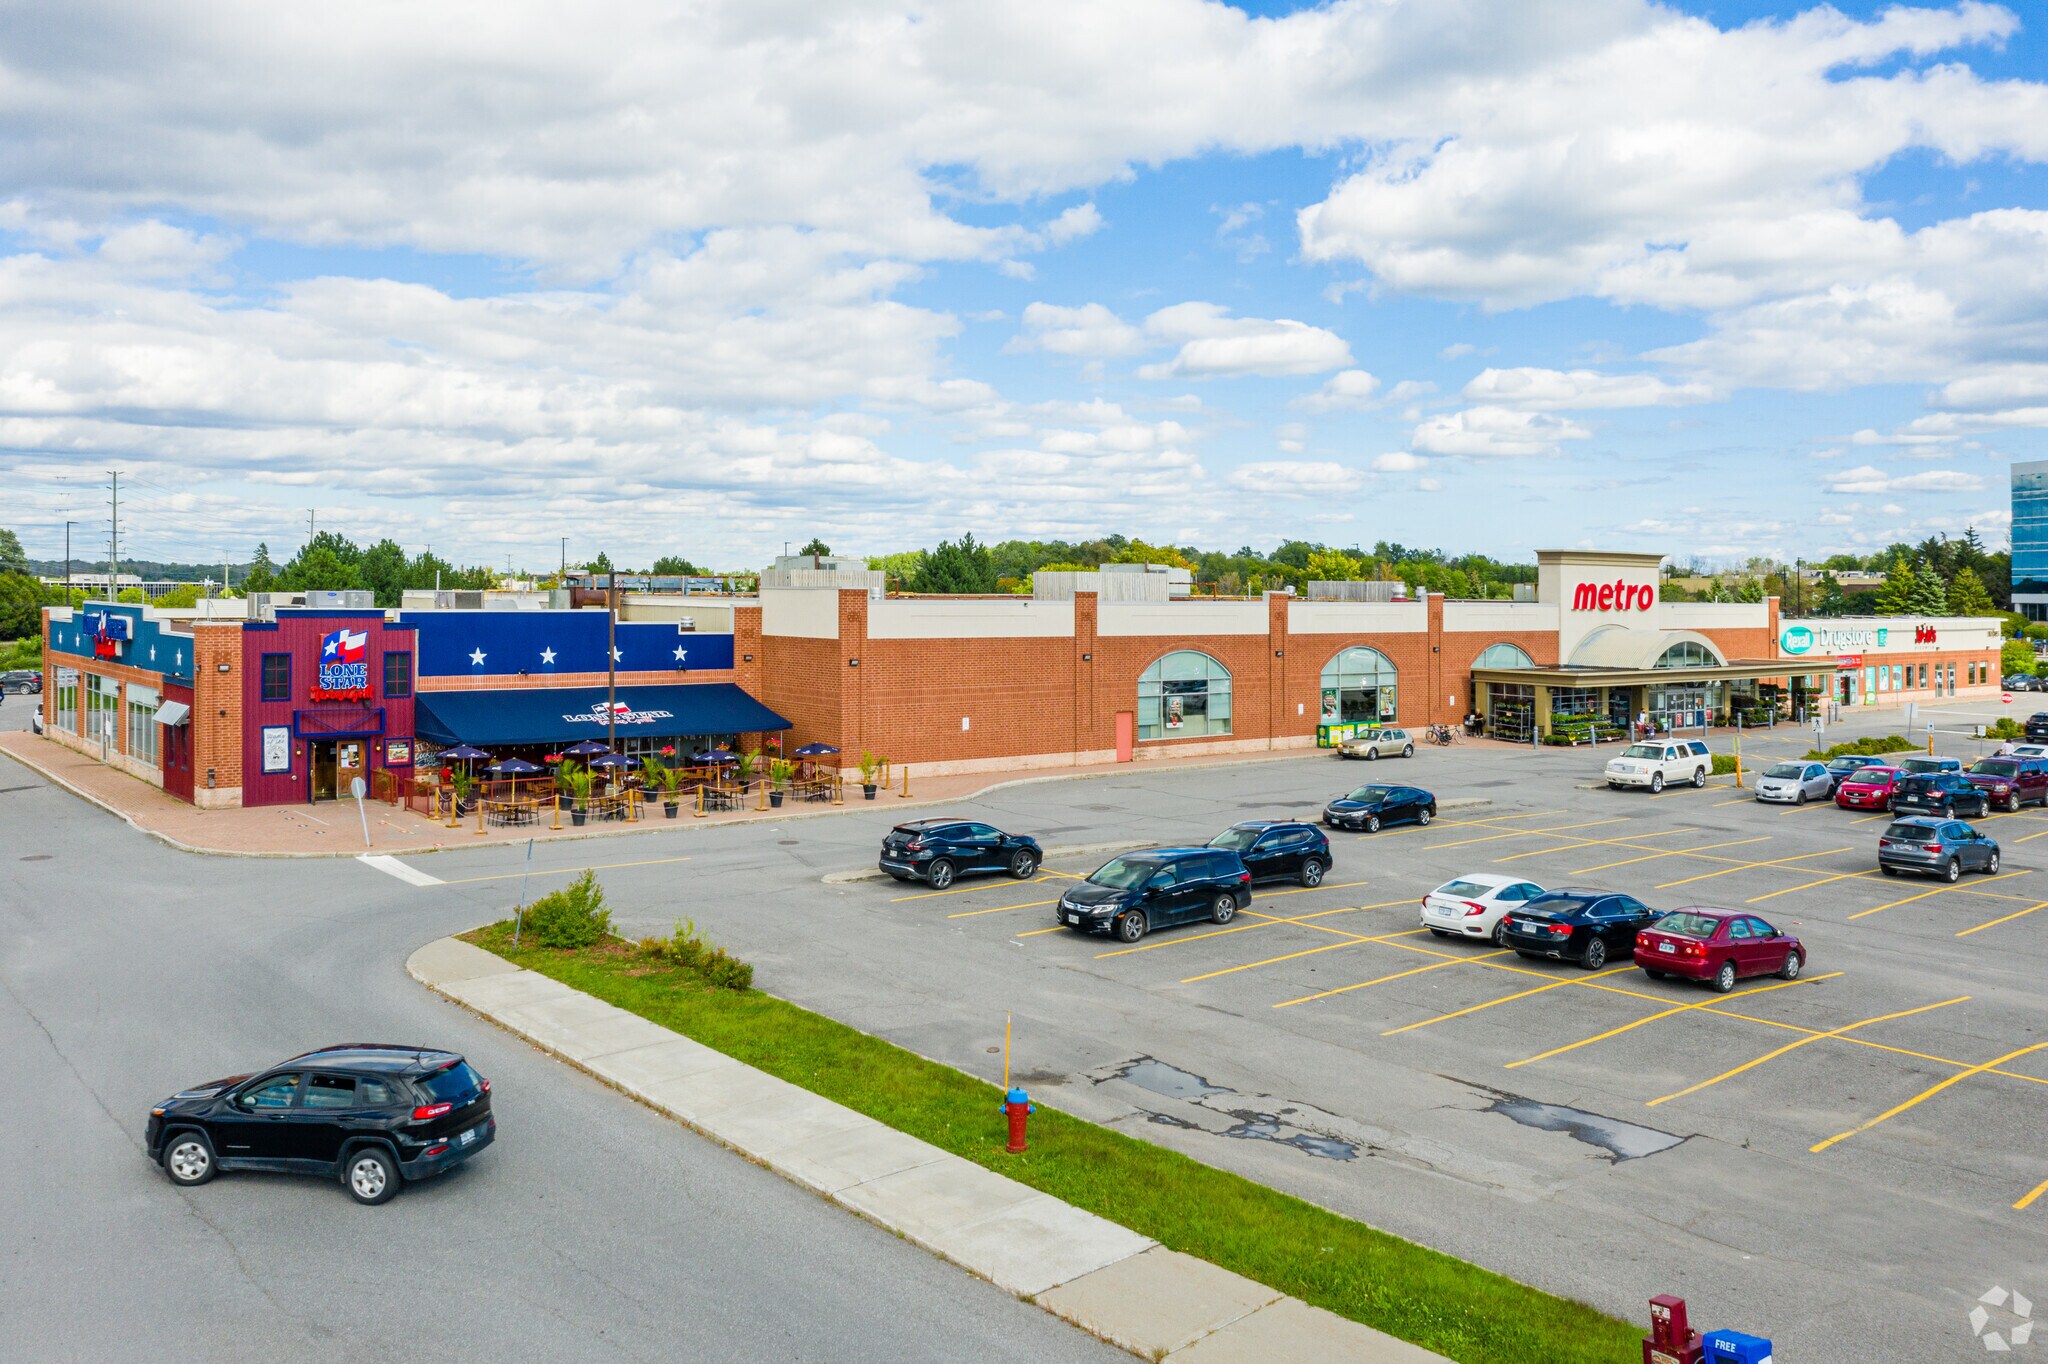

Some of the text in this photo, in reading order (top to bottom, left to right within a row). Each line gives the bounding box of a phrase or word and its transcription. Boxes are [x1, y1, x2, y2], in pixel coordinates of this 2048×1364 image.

[1573, 578, 1654, 611] metro
[1786, 631, 1811, 650] Rexall
[1820, 627, 1873, 650] Drugstore
[319, 663, 368, 677] LONE
[319, 675, 369, 690] STAR
[1715, 1339, 1736, 1353] FREE
